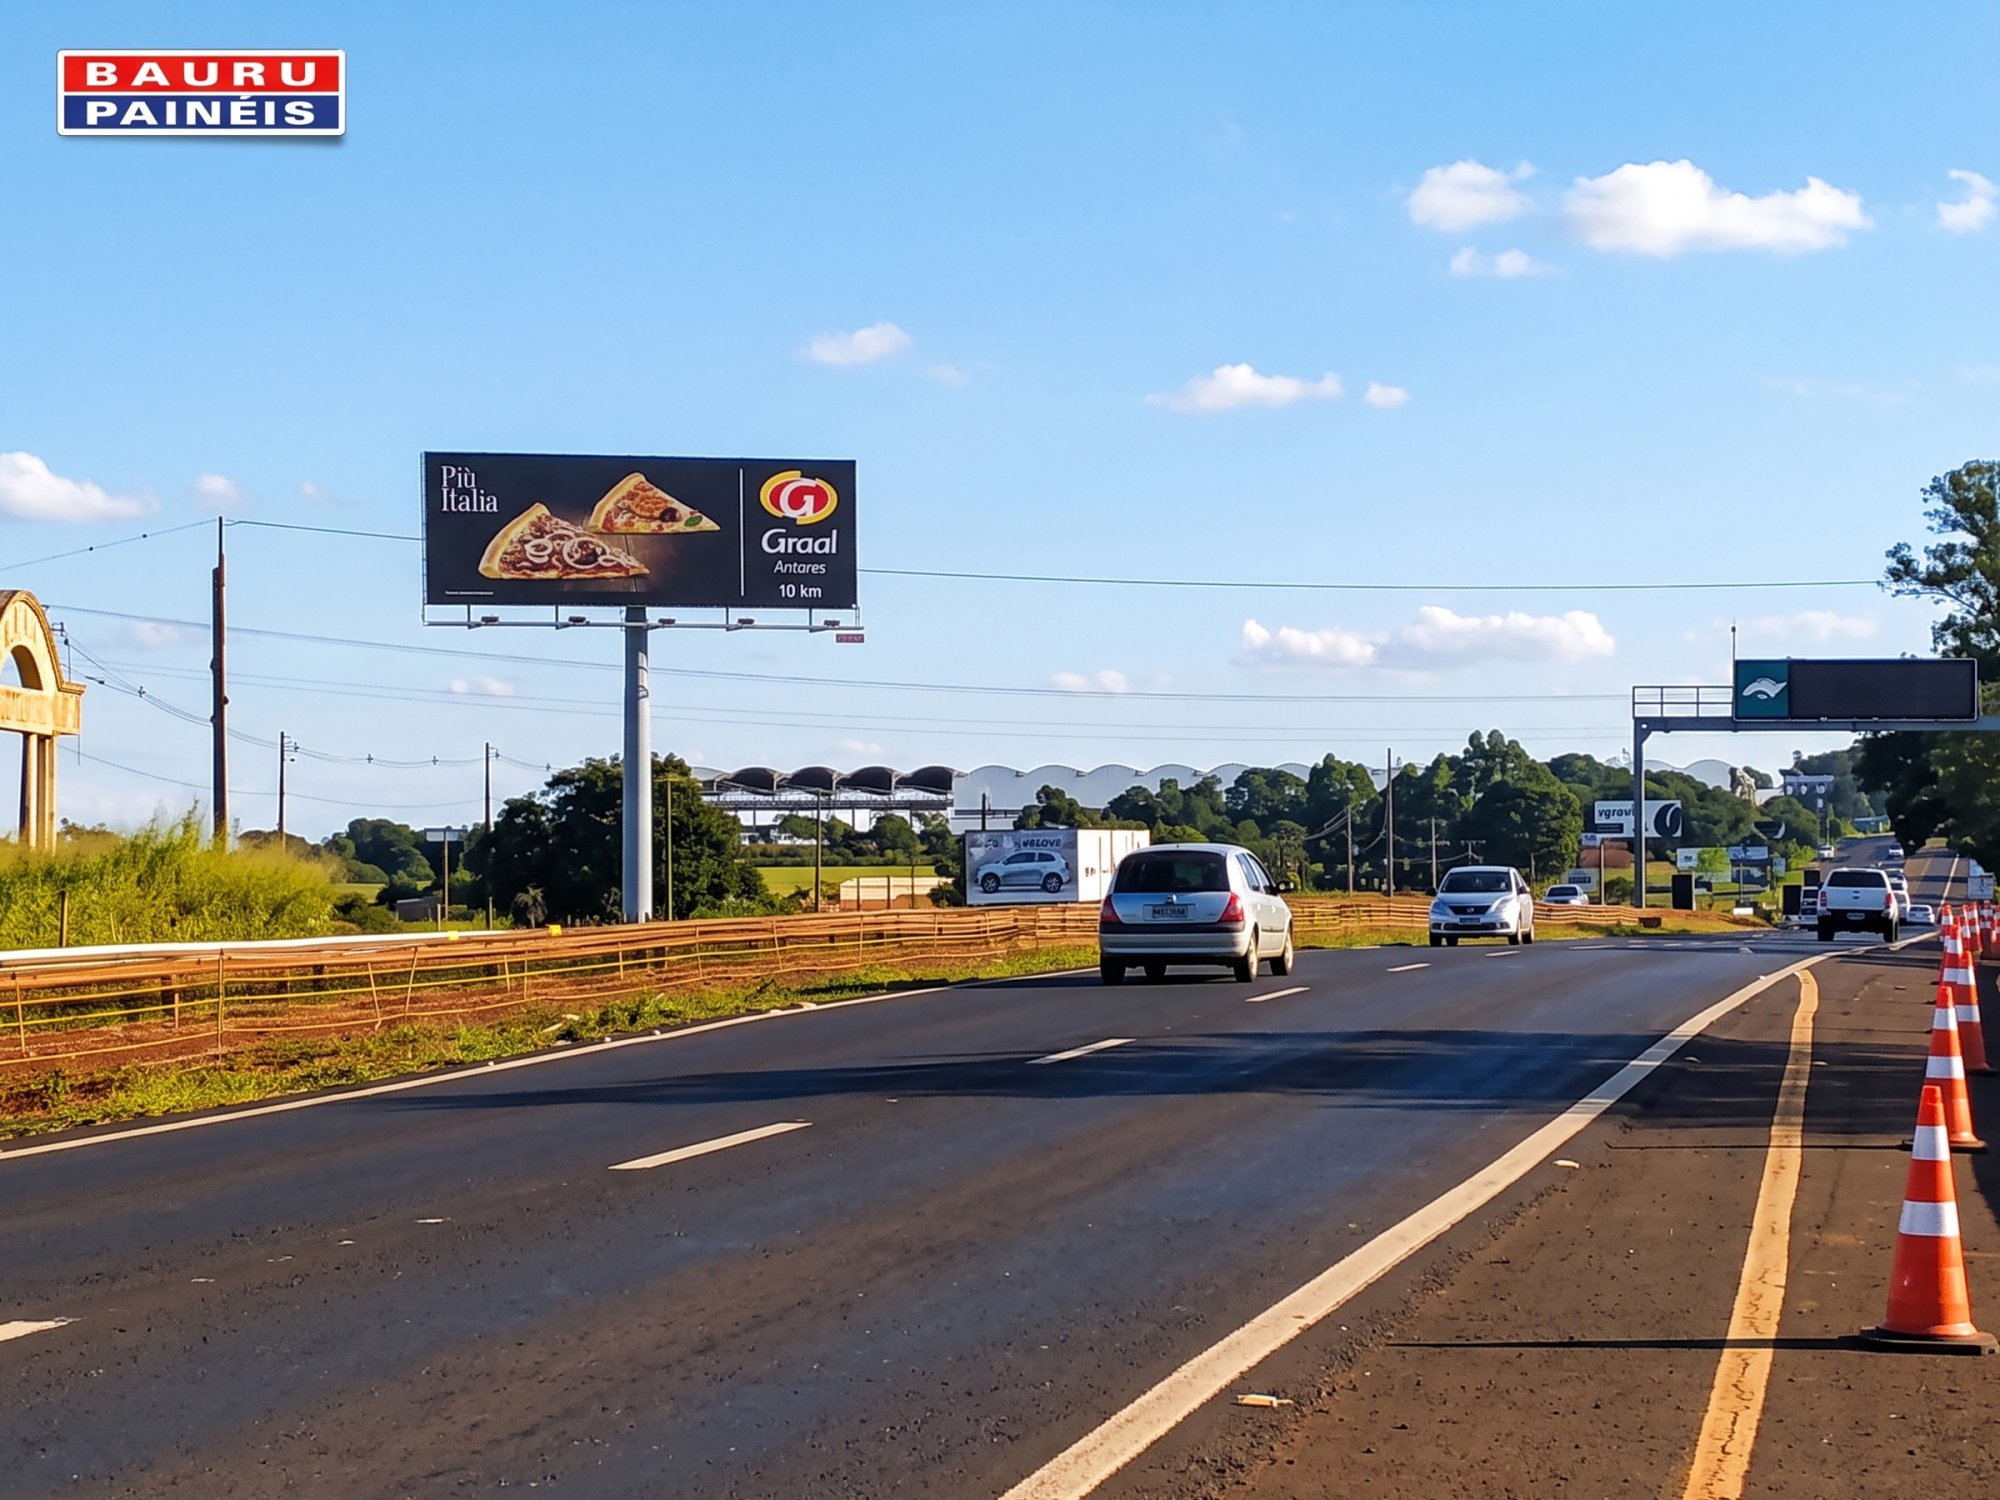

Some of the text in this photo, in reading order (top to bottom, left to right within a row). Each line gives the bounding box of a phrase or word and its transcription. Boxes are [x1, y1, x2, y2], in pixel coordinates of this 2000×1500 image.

[440, 465, 476, 488] Più
[441, 488, 499, 513] Italia
[761, 528, 838, 554] Graal
[773, 560, 826, 574] Antares
[779, 584, 822, 598] 10 km
